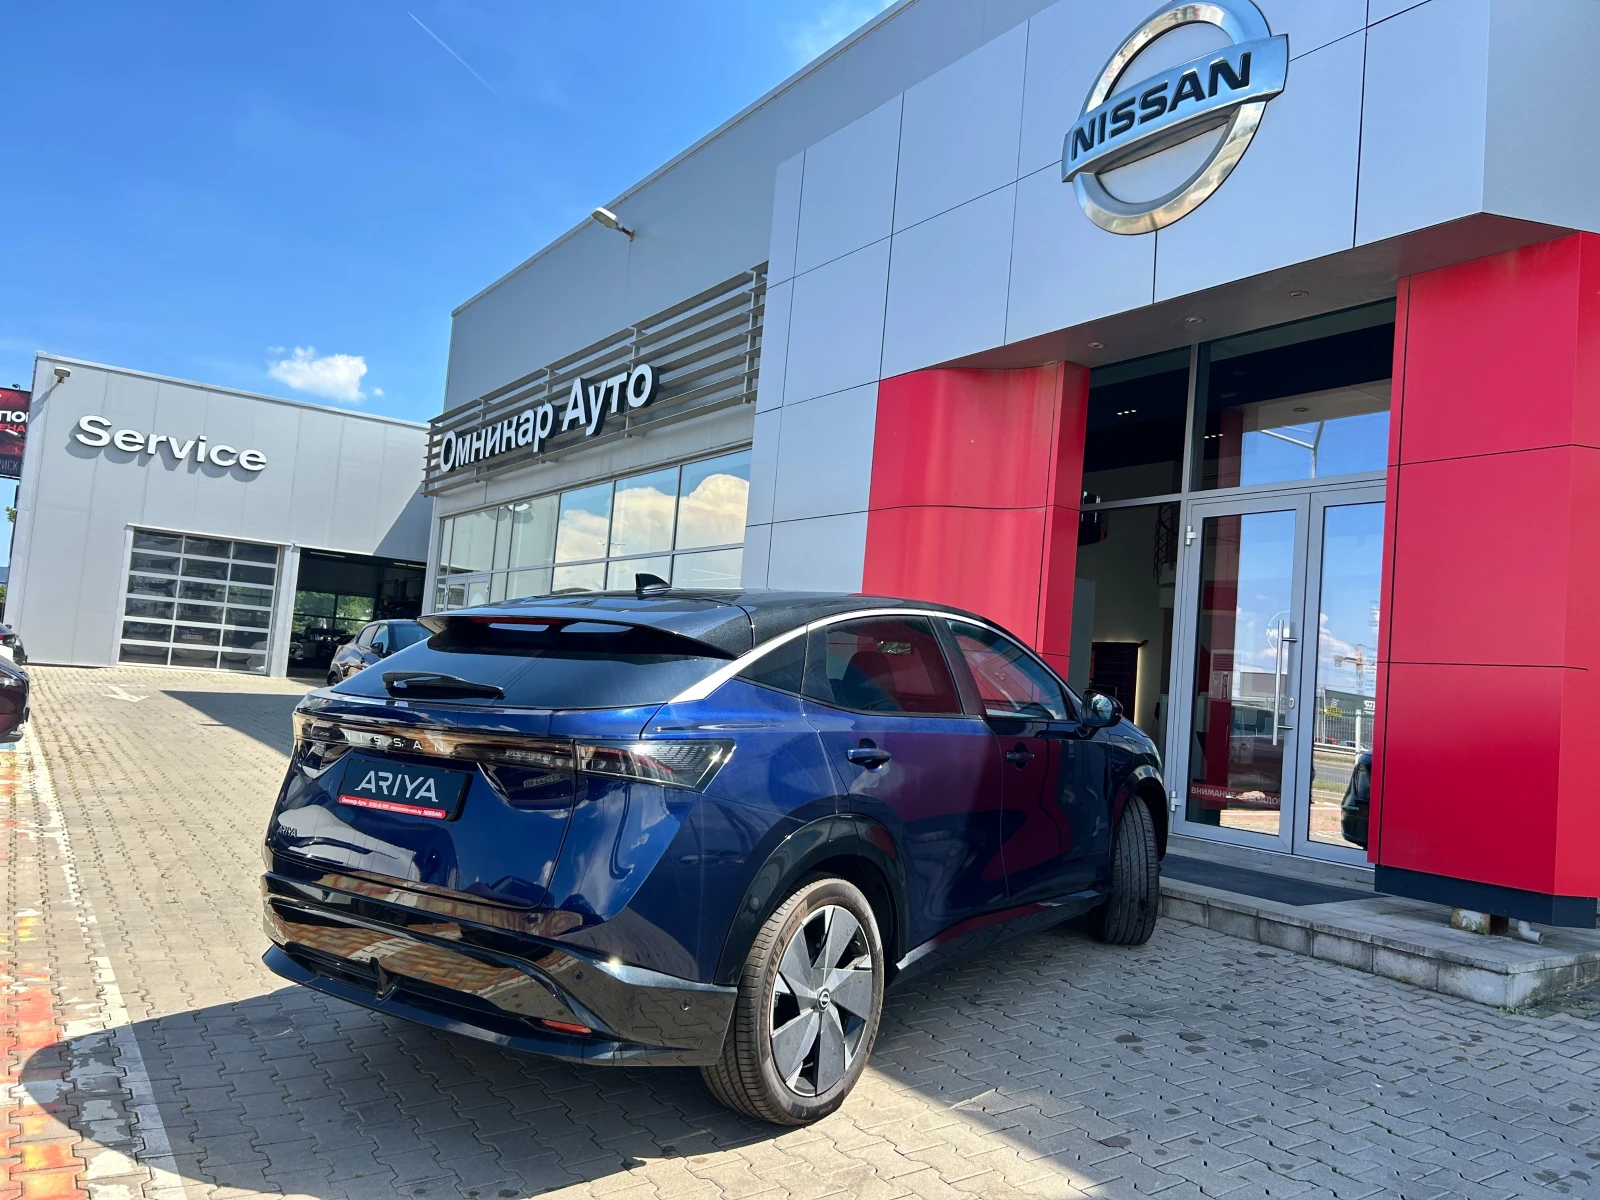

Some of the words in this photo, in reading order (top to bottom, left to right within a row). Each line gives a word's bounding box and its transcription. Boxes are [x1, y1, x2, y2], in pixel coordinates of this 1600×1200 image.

[1071, 51, 1252, 162] NISSAN
[75, 414, 268, 472] Service
[440, 403, 556, 473] Омникар
[561, 363, 656, 437] Ауто
[344, 732, 444, 752] NISSAN
[354, 770, 439, 802] ARIYA
